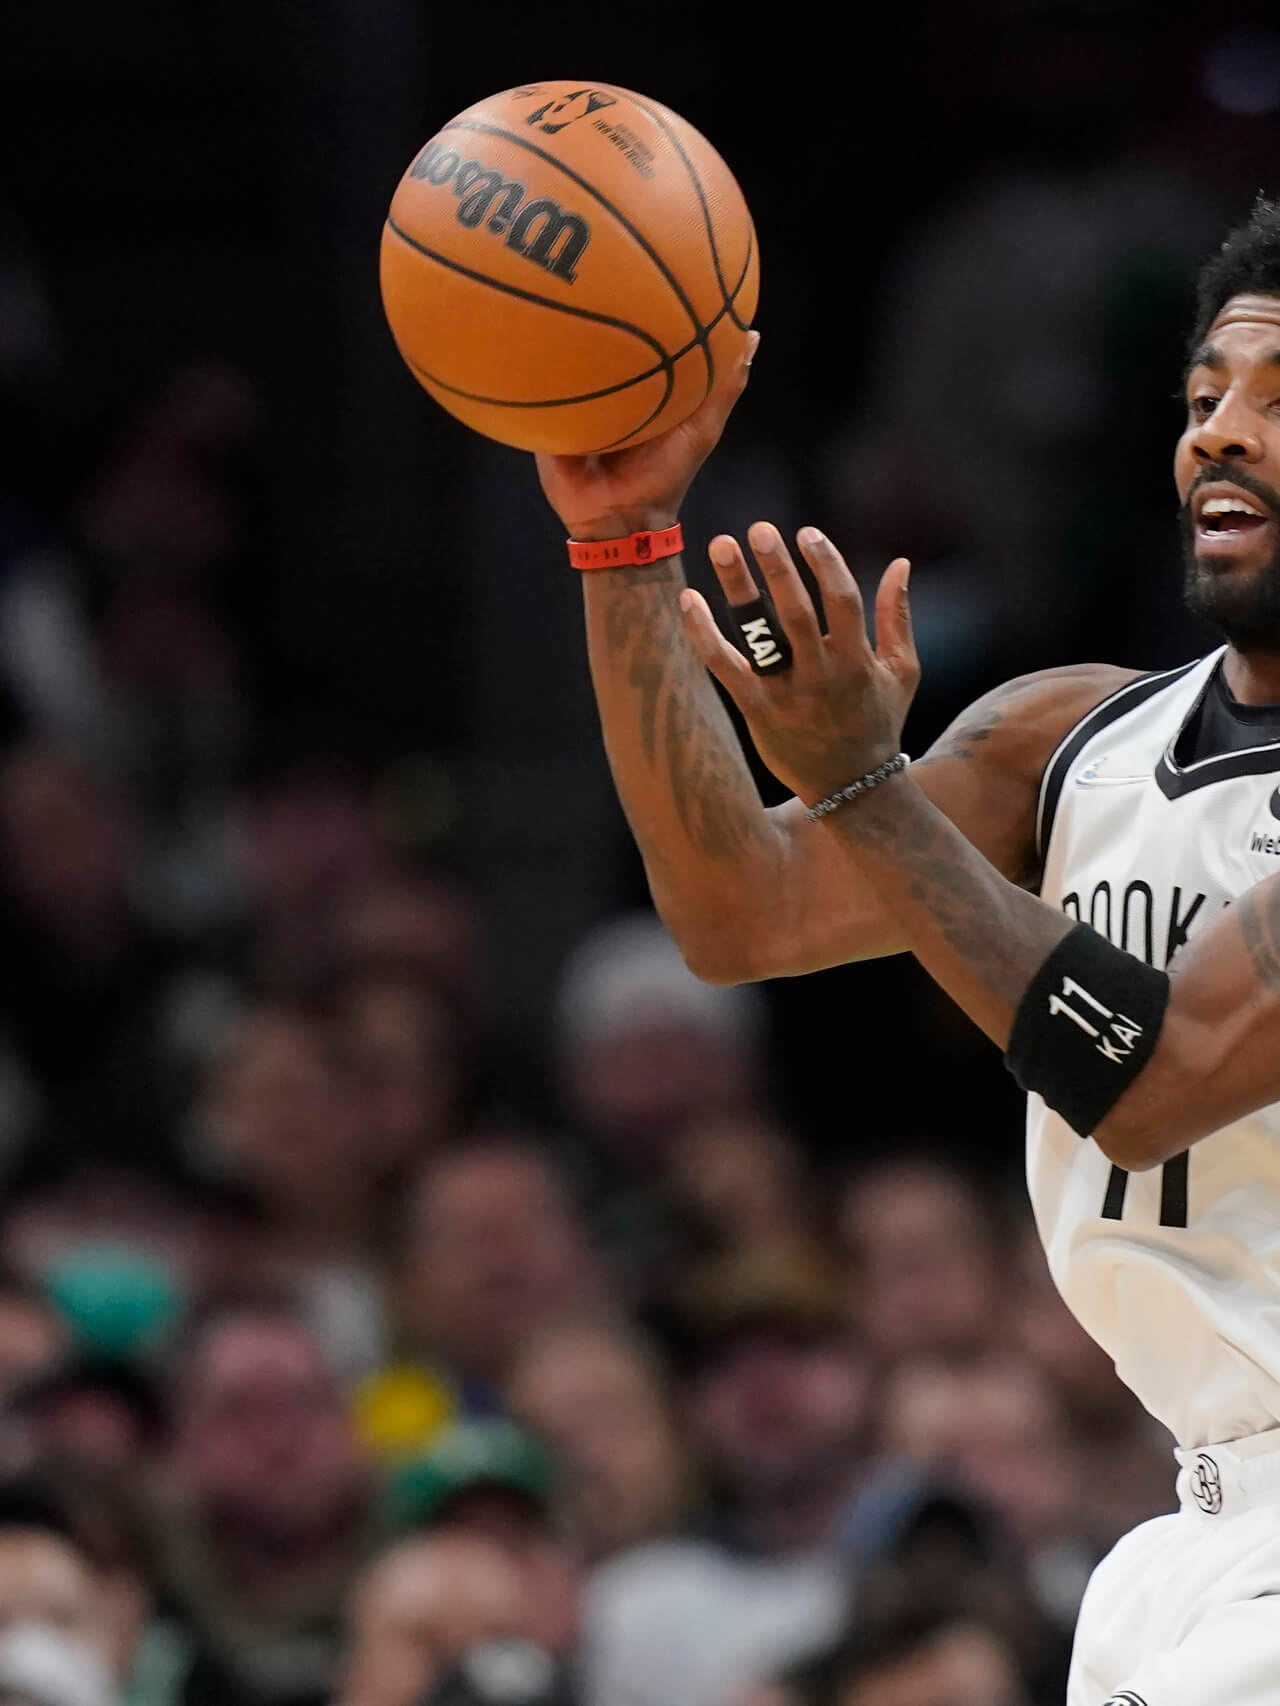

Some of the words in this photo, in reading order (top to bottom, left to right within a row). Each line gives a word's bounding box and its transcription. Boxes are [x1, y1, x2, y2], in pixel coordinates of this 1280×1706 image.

[409, 140, 591, 286] Wilson
[740, 616, 783, 668] KAI
[1047, 975, 1114, 1038] 11
[1095, 1012, 1144, 1065] KAI
